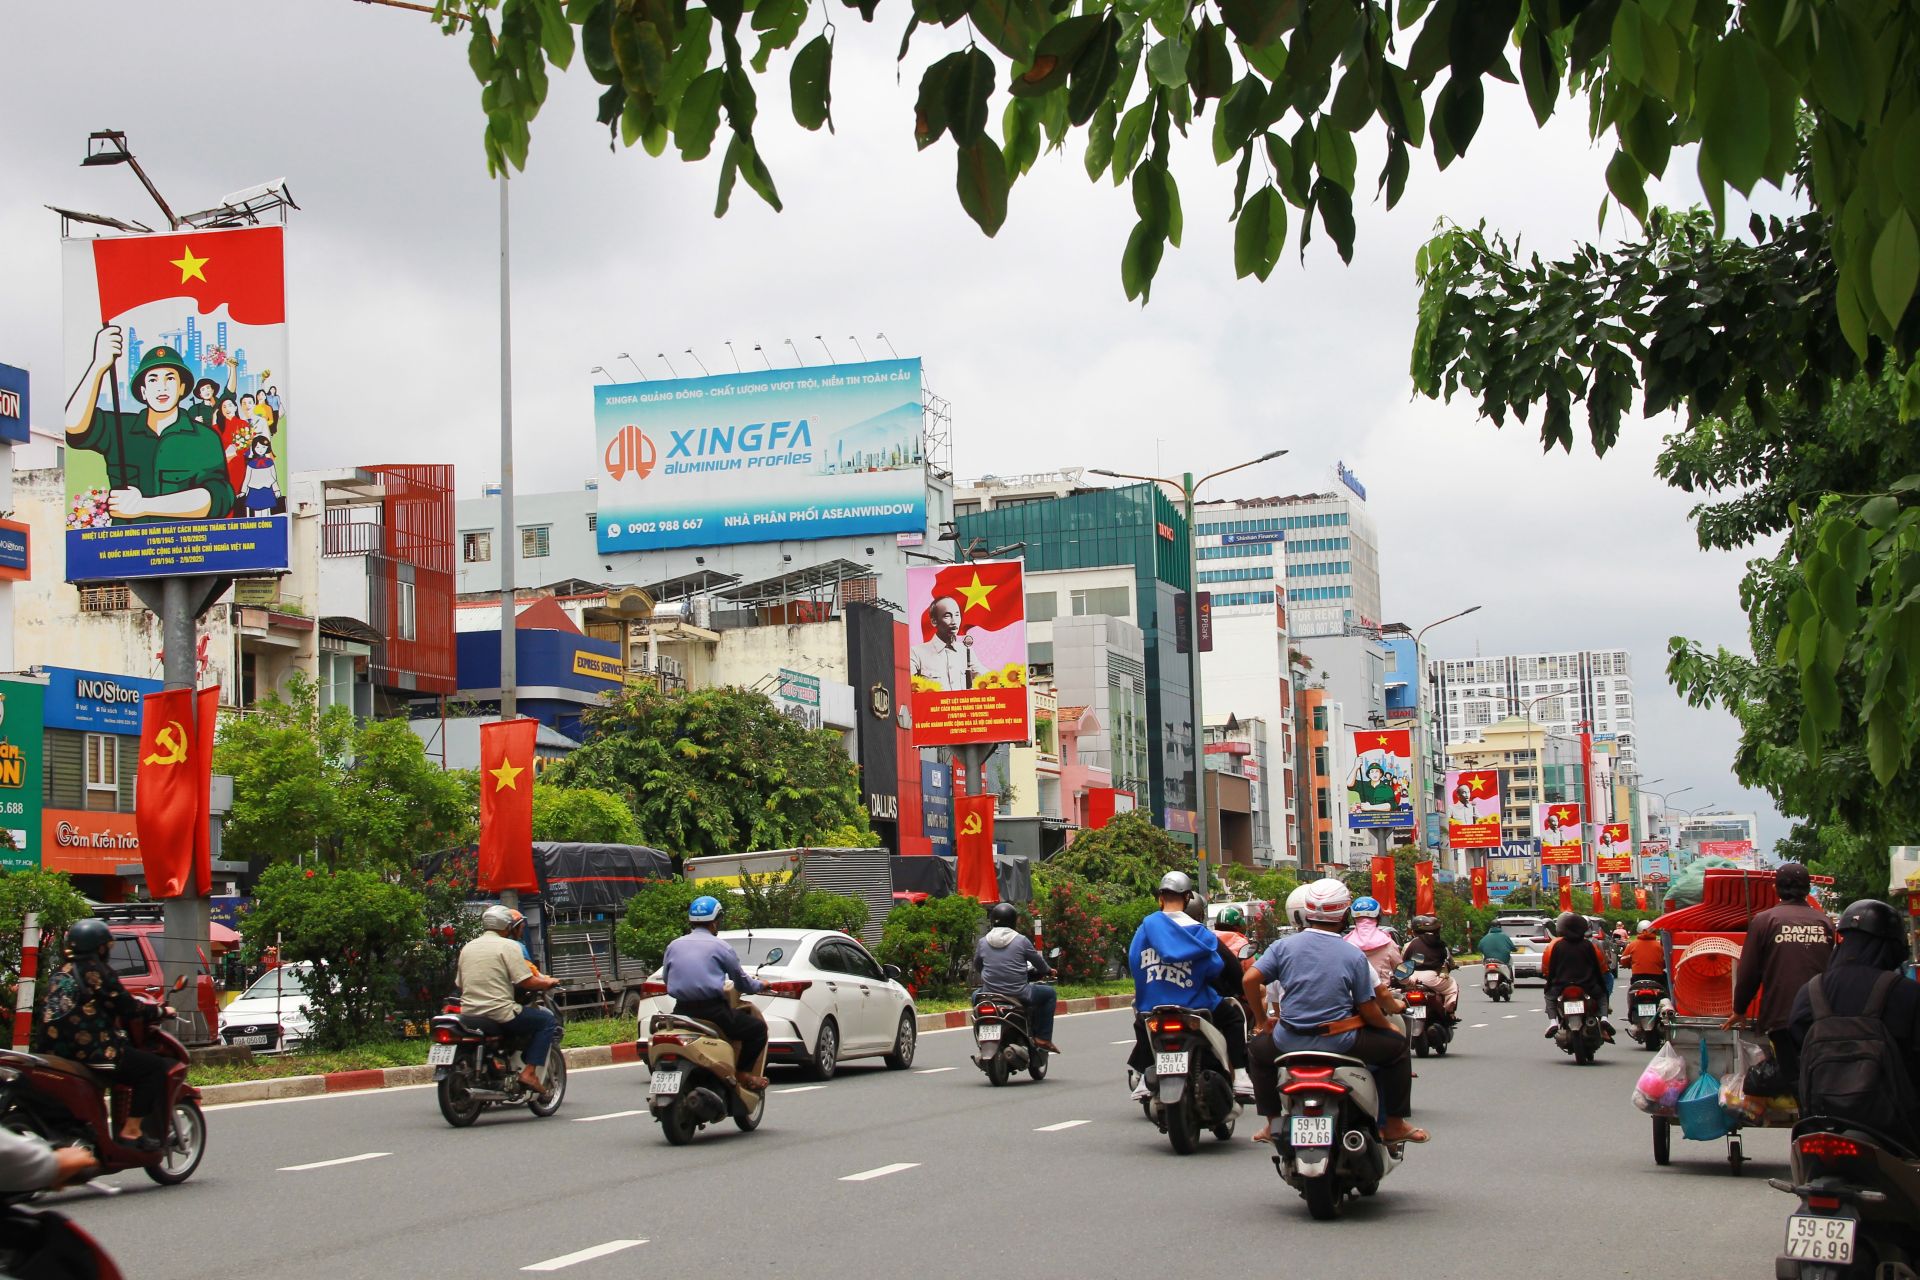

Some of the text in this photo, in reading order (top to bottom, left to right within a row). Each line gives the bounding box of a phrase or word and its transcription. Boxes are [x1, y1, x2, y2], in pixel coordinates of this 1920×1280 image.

[605, 395, 638, 406] XINGFA
[640, 390, 673, 402] QUẢNG
[676, 388, 704, 400] ĐÔNG
[710, 384, 735, 396] CHẤT
[737, 382, 768, 396] LƯỢNG
[770, 380, 794, 391] VƯỢT
[846, 376, 860, 384] TIN
[862, 372, 888, 384] TOÀN
[666, 419, 812, 459] XINGFA
[724, 503, 914, 526] NHÀ PHÂN PHỐI ASEANWINDOW
[82, 531, 97, 540] NHIỆT
[98, 530, 108, 540] LIỆT
[110, 528, 124, 538] CHÀO
[124, 528, 140, 537] MỪNG
[148, 526, 162, 535] NĂM
[162, 525, 176, 534] NGÀY
[178, 524, 192, 533] CÁCH
[192, 524, 208, 534] MẠNG
[209, 522, 226, 531] THÁNG
[228, 522, 239, 530] TÁM
[240, 520, 257, 530] THÀNH
[258, 520, 272, 528] CÔNG
[628, 518, 704, 534] 0902 988 667
[99, 542, 256, 560] VÀ QUỐC KHÁNH NƯỚC CỘNG HÒA XÃ HỘI CHỦ NGHĨA VIỆT NAM
[1292, 608, 1340, 620] FOR RENT
[577, 656, 622, 676] EXPRESS SERVICE
[872, 794, 898, 820] DALLAS
[1774, 934, 1829, 944] ORIGINA
[1782, 925, 1824, 934] DAVIES
[1297, 1118, 1326, 1130] 59-V3
[1294, 1132, 1330, 1144] 162.66
[1797, 1218, 1846, 1240] 59-G2
[1790, 1238, 1850, 1260] 776.99
